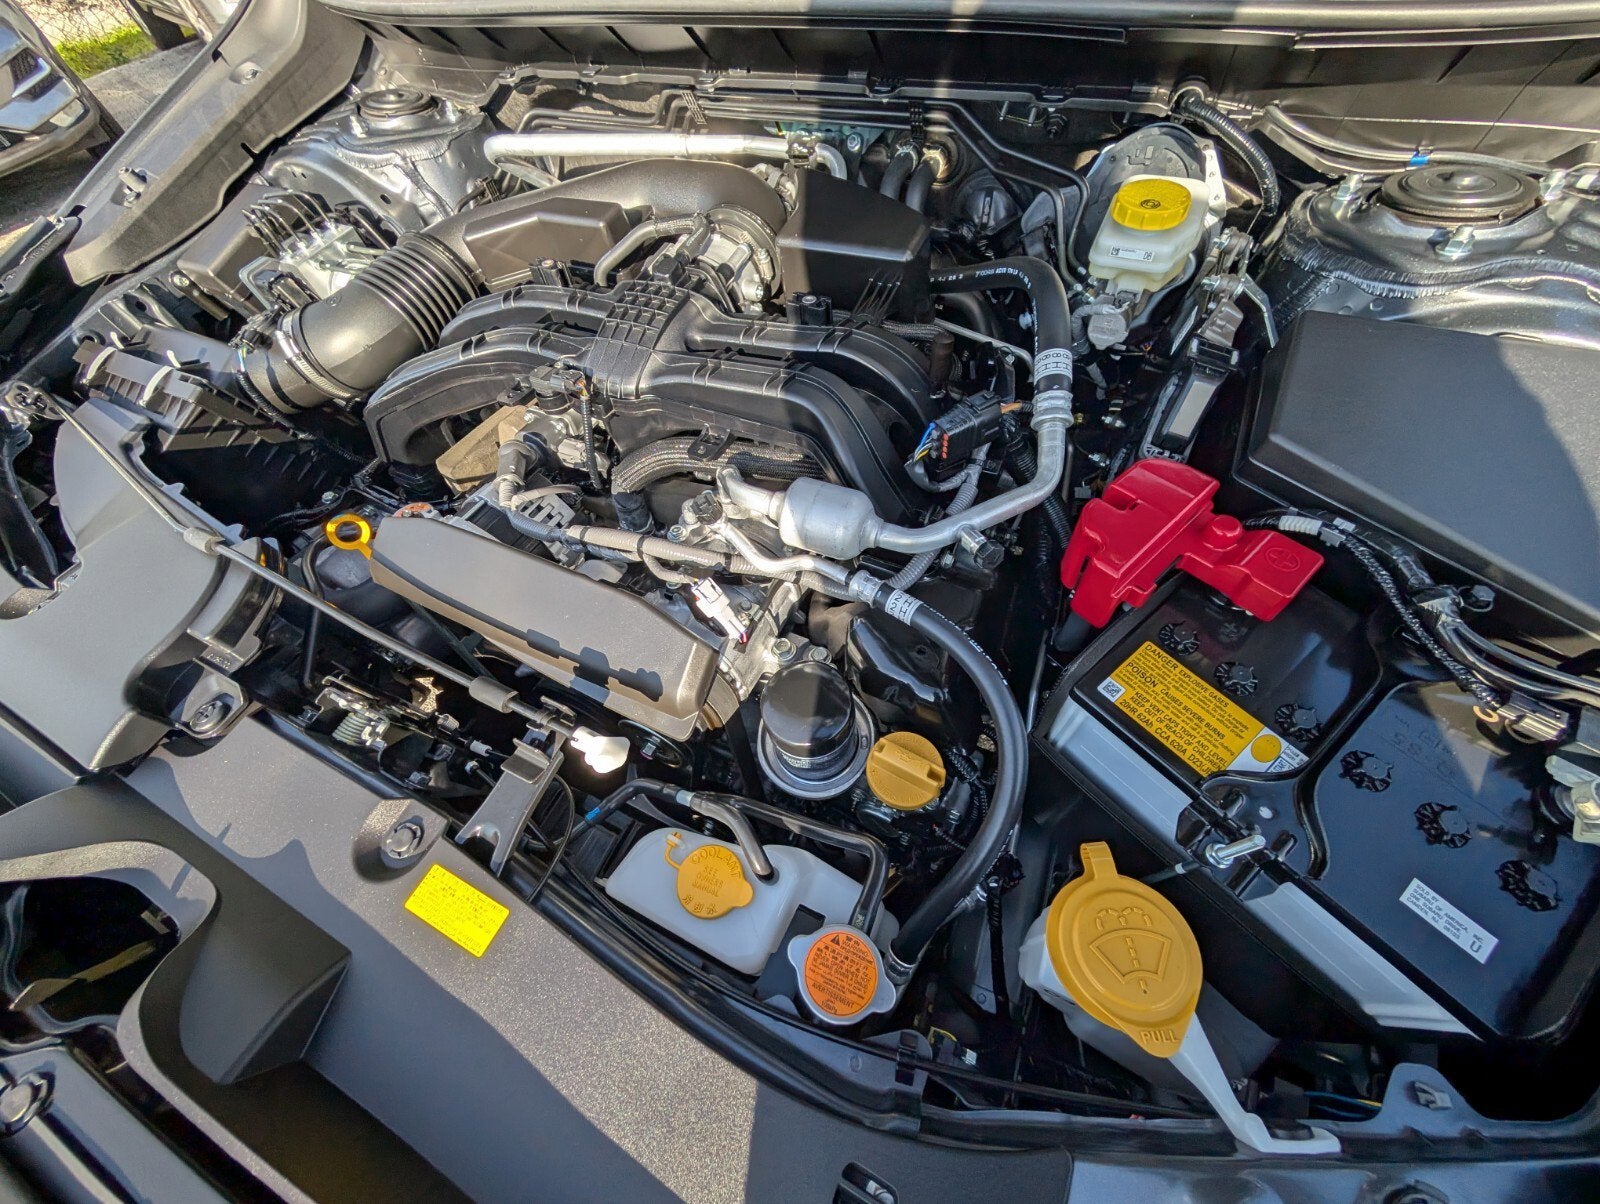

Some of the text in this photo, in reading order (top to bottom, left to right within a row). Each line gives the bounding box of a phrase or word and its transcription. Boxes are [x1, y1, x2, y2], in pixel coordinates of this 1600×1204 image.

[1146, 645, 1230, 708] DANGER EXPLOSIVE GASES
[1126, 662, 1227, 740] POISON CAUSES SEVERE BURNS
[1119, 699, 1139, 716] 20HR
[1136, 712, 1155, 729] 62Ah
[1154, 727, 1172, 742] CCA
[1169, 739, 1189, 756] 620A
[1129, 696, 1145, 710] KEEP
[1144, 707, 1157, 719] OUT
[1155, 717, 1165, 725] OF
[1164, 723, 1185, 741] REACH
[1184, 739, 1194, 748] OF
[1134, 691, 1230, 767] KEEP VENT CAPS TIGHT AND LEVEL
[690, 846, 741, 879] COOLANT
[1413, 888, 1434, 906] SUBARU
[1435, 905, 1443, 913] OF
[1416, 884, 1430, 896] SOLD
[1410, 893, 1421, 902] ONE
[1422, 902, 1443, 920] SUBARU
[1469, 940, 1482, 954] U
[812, 982, 855, 1008] AVERTISSEMENT
[1139, 1030, 1180, 1045] PULL
